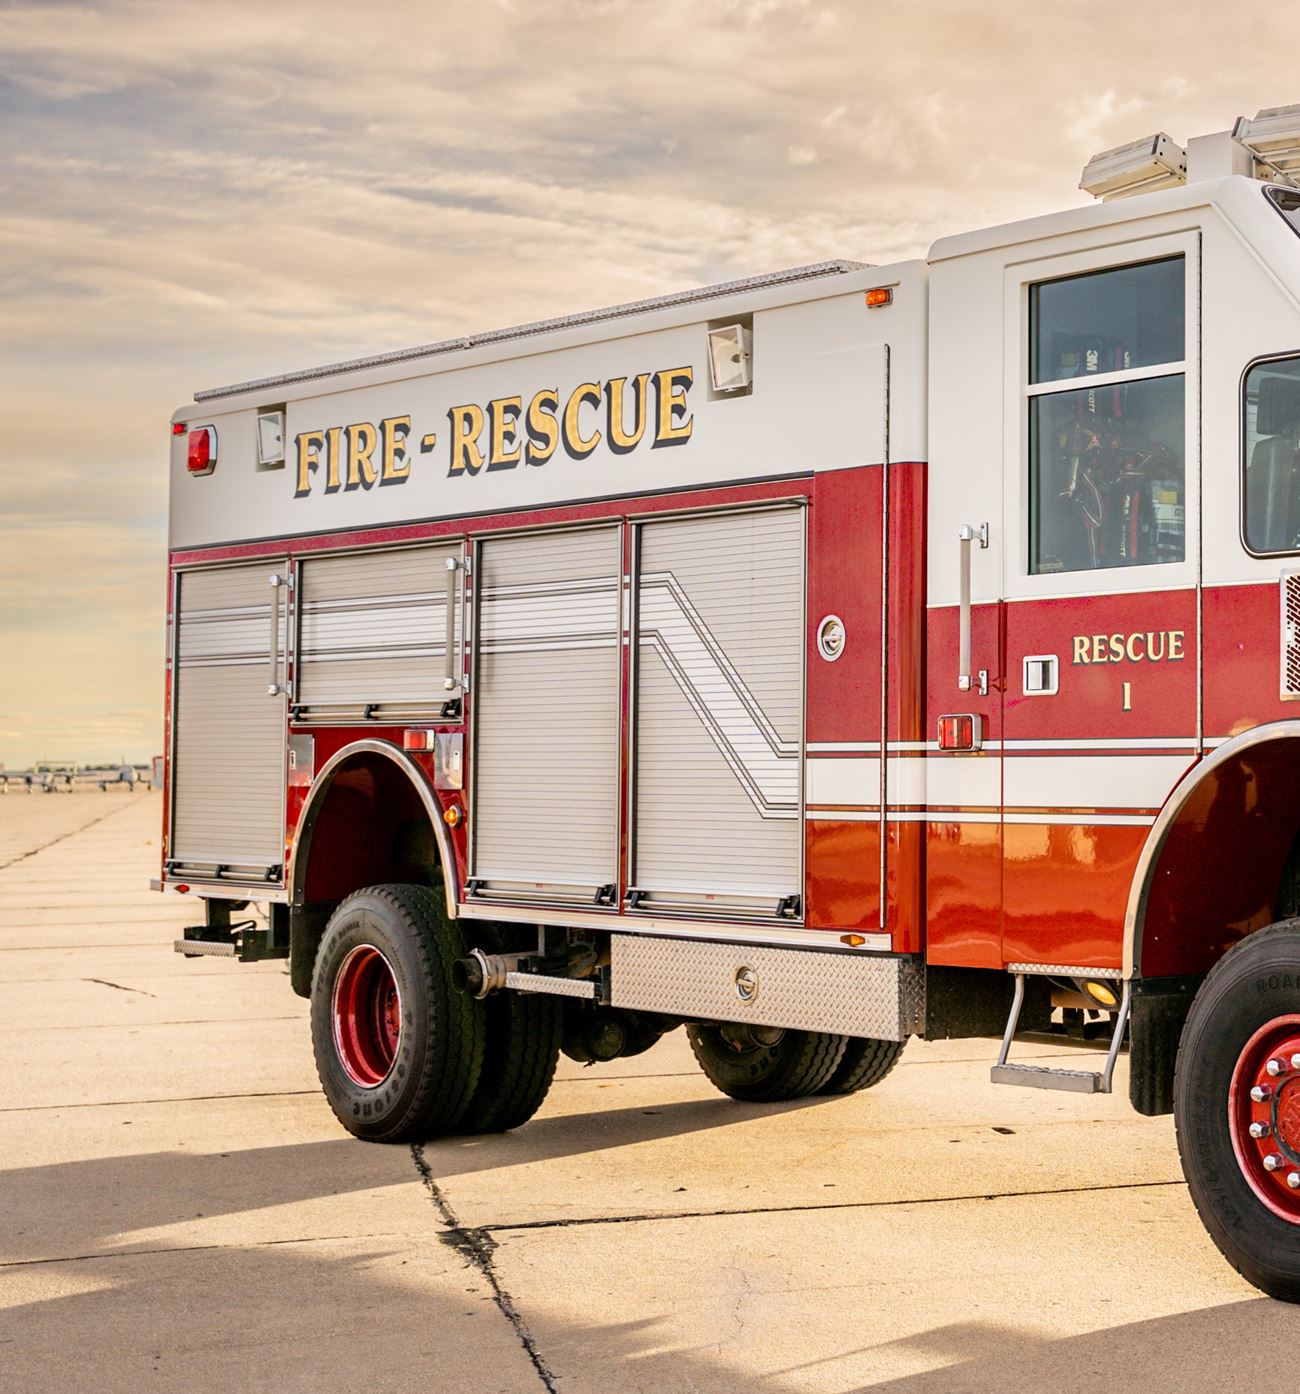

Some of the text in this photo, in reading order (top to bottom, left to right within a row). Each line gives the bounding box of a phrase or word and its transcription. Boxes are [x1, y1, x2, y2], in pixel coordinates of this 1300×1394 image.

[1086, 350, 1098, 371] 3M
[294, 414, 411, 499] FIRE
[447, 366, 695, 478] RESCUE
[1072, 630, 1186, 666] RESCUE
[1123, 682, 1132, 711] 1
